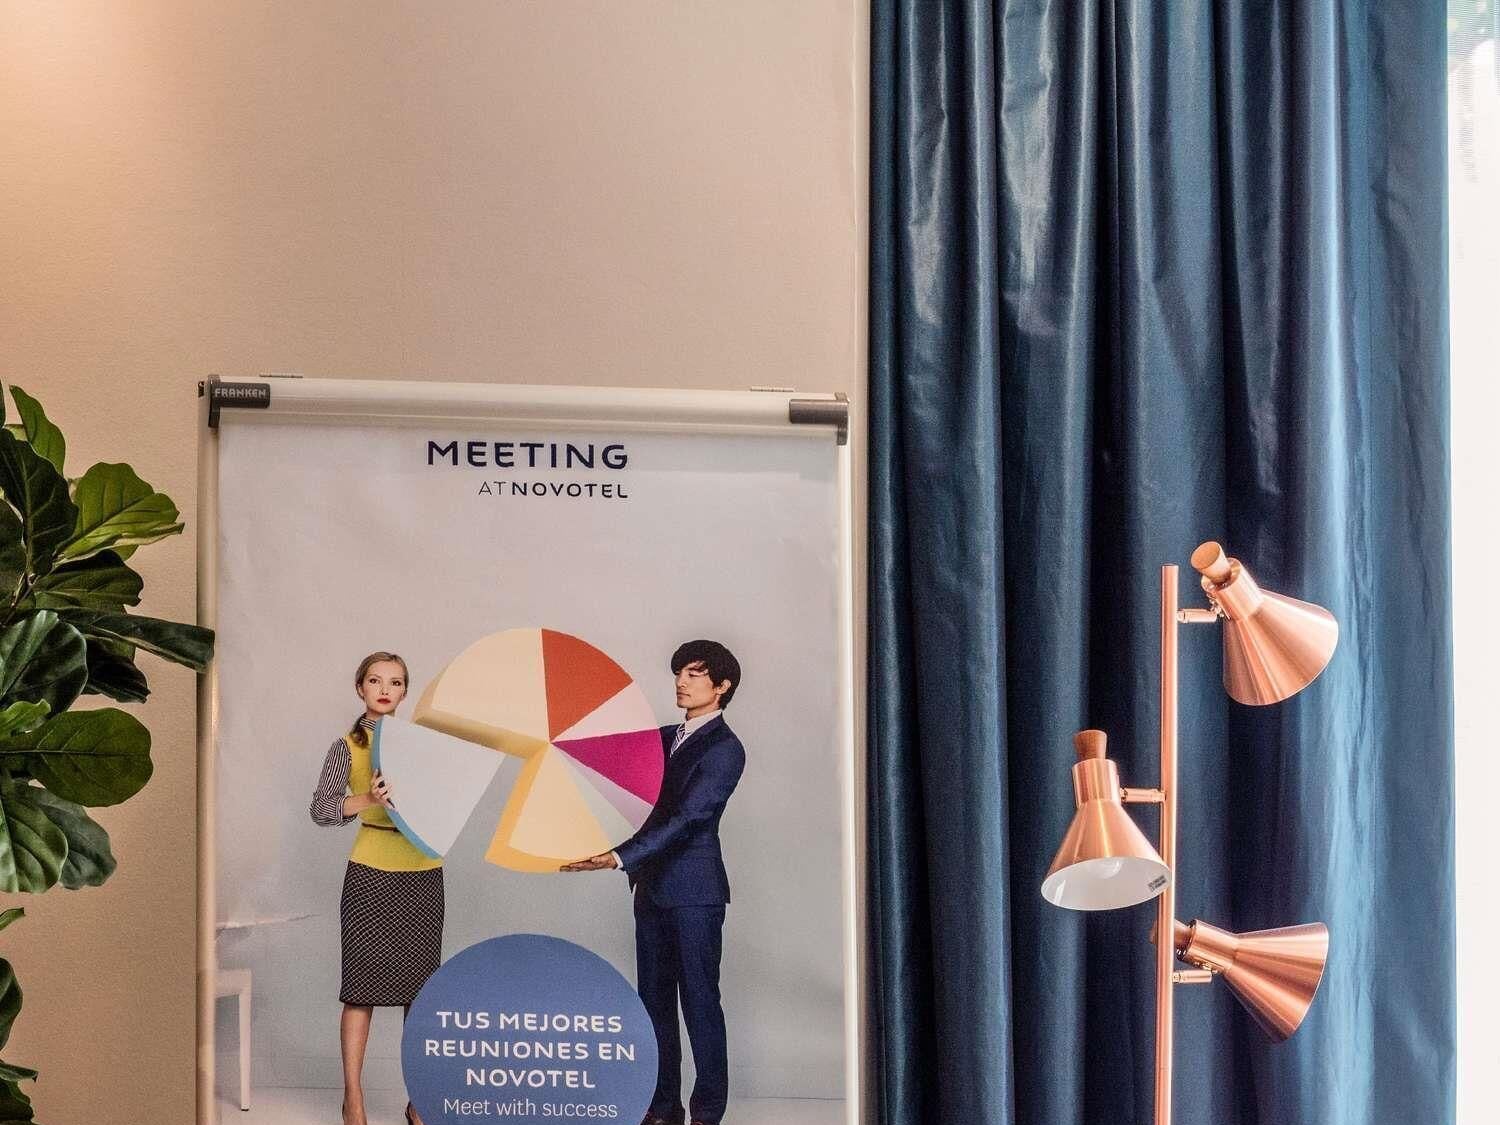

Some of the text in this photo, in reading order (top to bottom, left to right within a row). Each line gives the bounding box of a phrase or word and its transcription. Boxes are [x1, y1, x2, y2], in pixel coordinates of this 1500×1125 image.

[214, 387, 267, 398] FRANKEN
[427, 440, 628, 470] MEETING
[436, 1011, 622, 1033] TUS MEJORES
[424, 1040, 635, 1061] REUNIONES EN
[466, 1068, 596, 1089] NOVOTEL
[443, 1098, 618, 1119] Meet with success
